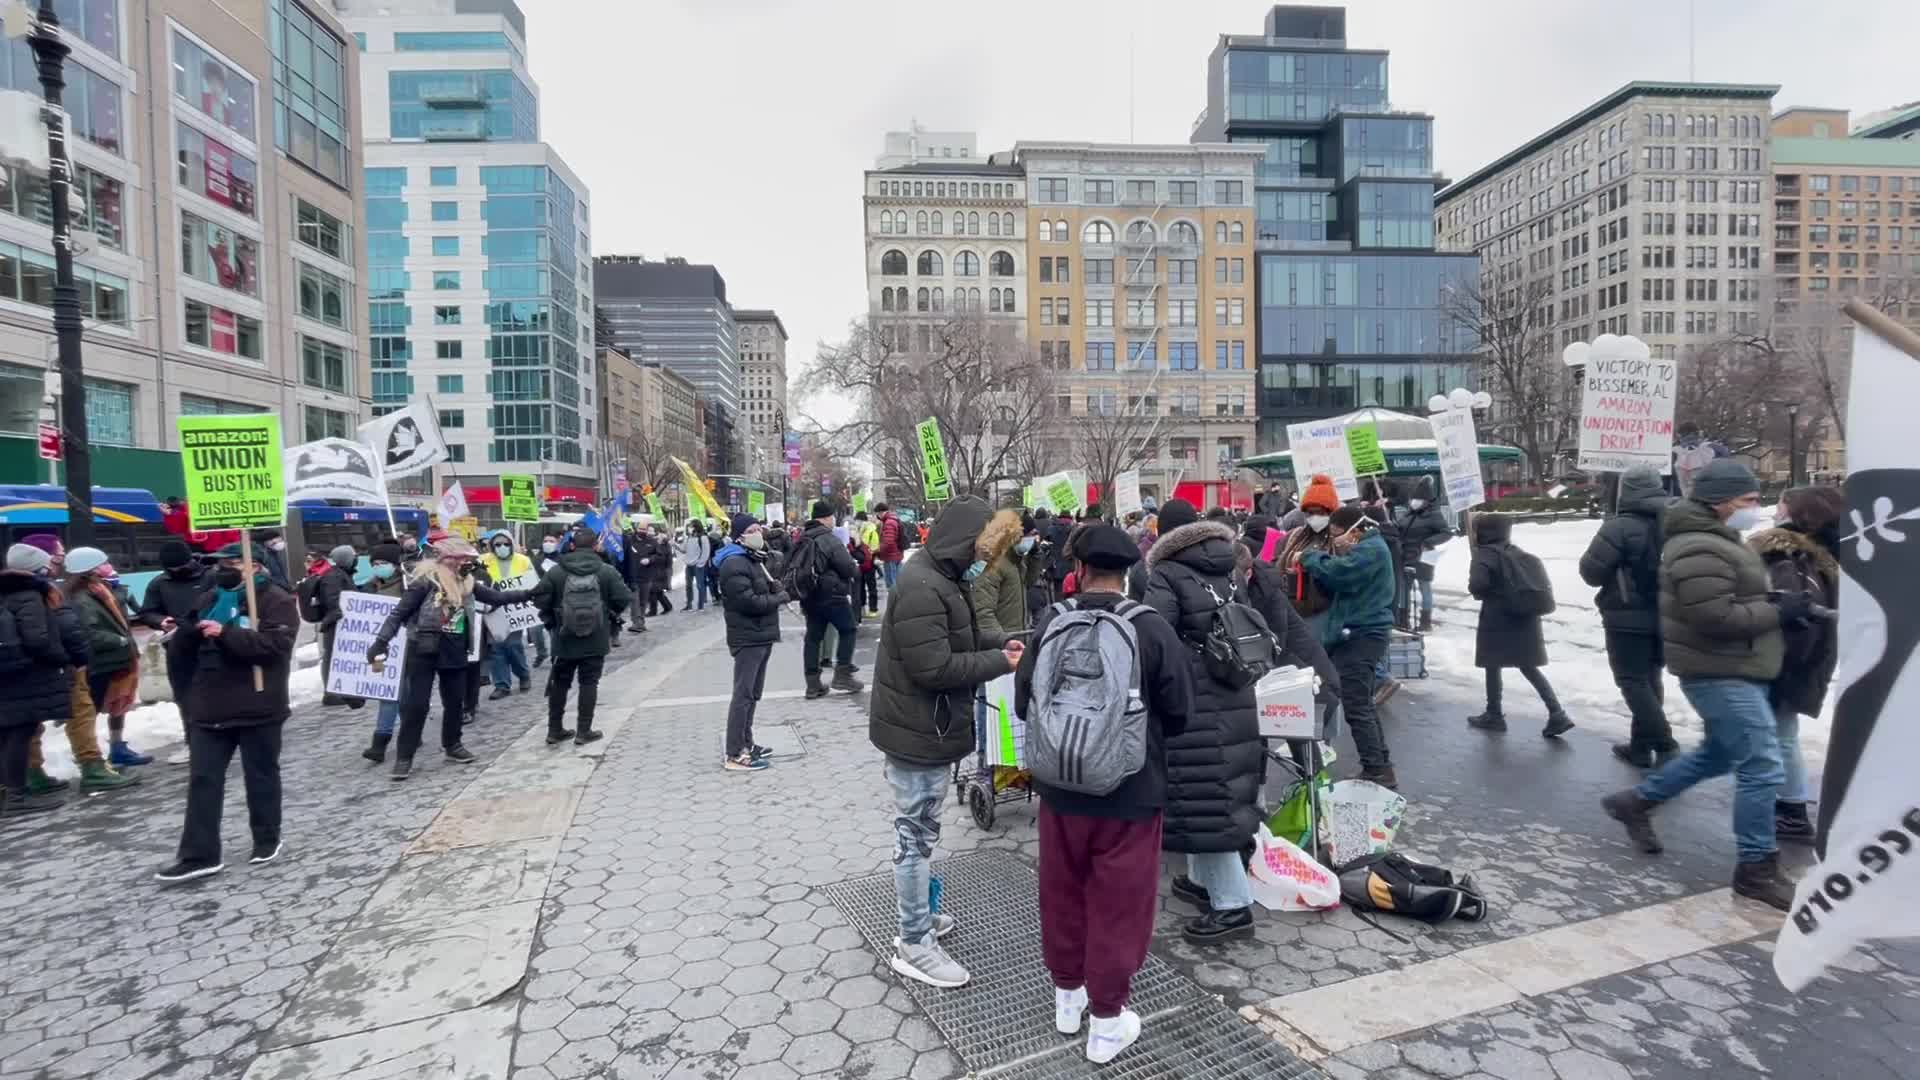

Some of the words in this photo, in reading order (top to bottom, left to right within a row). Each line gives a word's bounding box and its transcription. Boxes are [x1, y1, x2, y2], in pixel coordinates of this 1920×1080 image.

[1596, 360, 1652, 377] VICTORY
[1658, 365, 1673, 381] TO
[1653, 384, 1669, 399] AL
[1597, 397, 1652, 416] AMAZON
[1583, 416, 1672, 434] UNIONIZATION
[1600, 433, 1644, 449] DRIVE!
[192, 447, 267, 471] UNION
[203, 473, 272, 492] BUSTING
[199, 499, 280, 516] DISGUSTING!
[341, 618, 380, 636] AMAZ
[331, 658, 369, 675] RIGHT
[381, 664, 397, 679] TO
[334, 678, 342, 691] A
[355, 681, 396, 698] UNION
